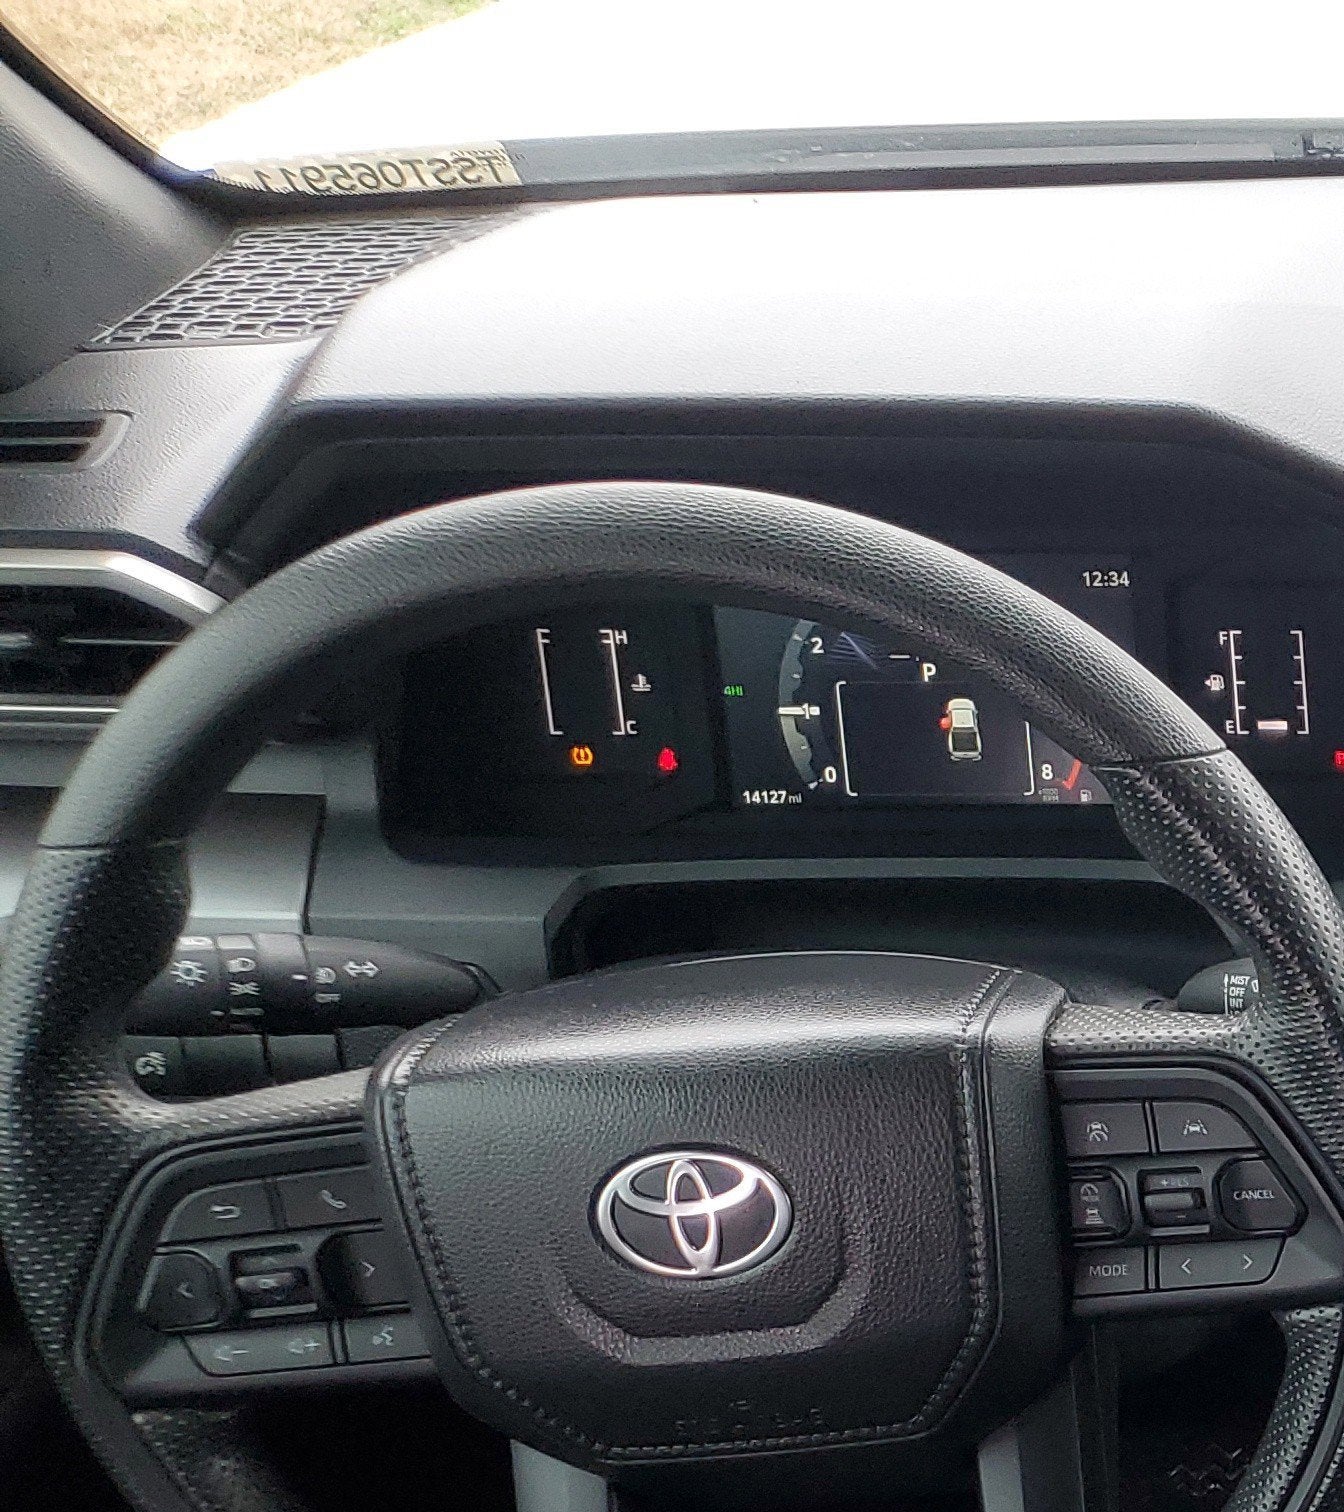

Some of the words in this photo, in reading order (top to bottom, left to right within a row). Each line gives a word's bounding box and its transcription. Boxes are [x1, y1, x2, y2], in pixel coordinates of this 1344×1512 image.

[1083, 571, 1130, 587] 12:34
[615, 630, 628, 645] H
[1219, 631, 1229, 646] F
[810, 637, 824, 654] 2
[922, 663, 937, 682] P
[802, 703, 810, 719] 1
[626, 720, 638, 735] C
[1225, 720, 1235, 734] E
[824, 766, 837, 783] 0
[1042, 764, 1054, 780] 8
[743, 790, 787, 804] 14127
[788, 793, 802, 804] mi
[1230, 975, 1251, 986] MIST
[1229, 986, 1246, 998] OFF
[1233, 1189, 1275, 1200] CANCEL
[1089, 1264, 1128, 1277] MODE
